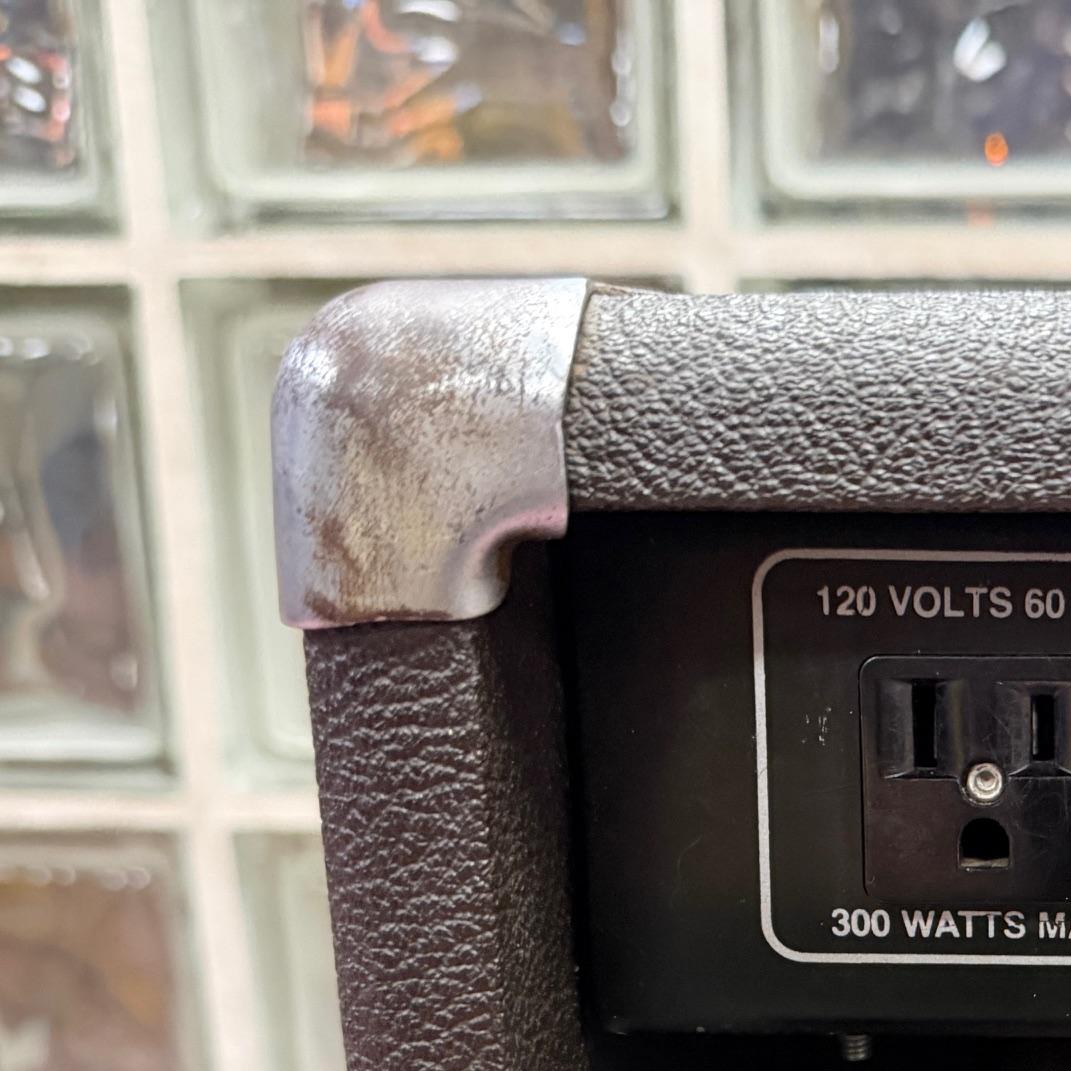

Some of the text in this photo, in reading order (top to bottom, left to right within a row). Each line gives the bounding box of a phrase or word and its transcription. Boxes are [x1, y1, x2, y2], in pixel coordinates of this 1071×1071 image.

[816, 586, 876, 616] 120
[888, 586, 1013, 618] VOLTS
[1024, 588, 1066, 618] 60
[831, 908, 890, 938] 300
[901, 910, 1026, 940] WATTS
